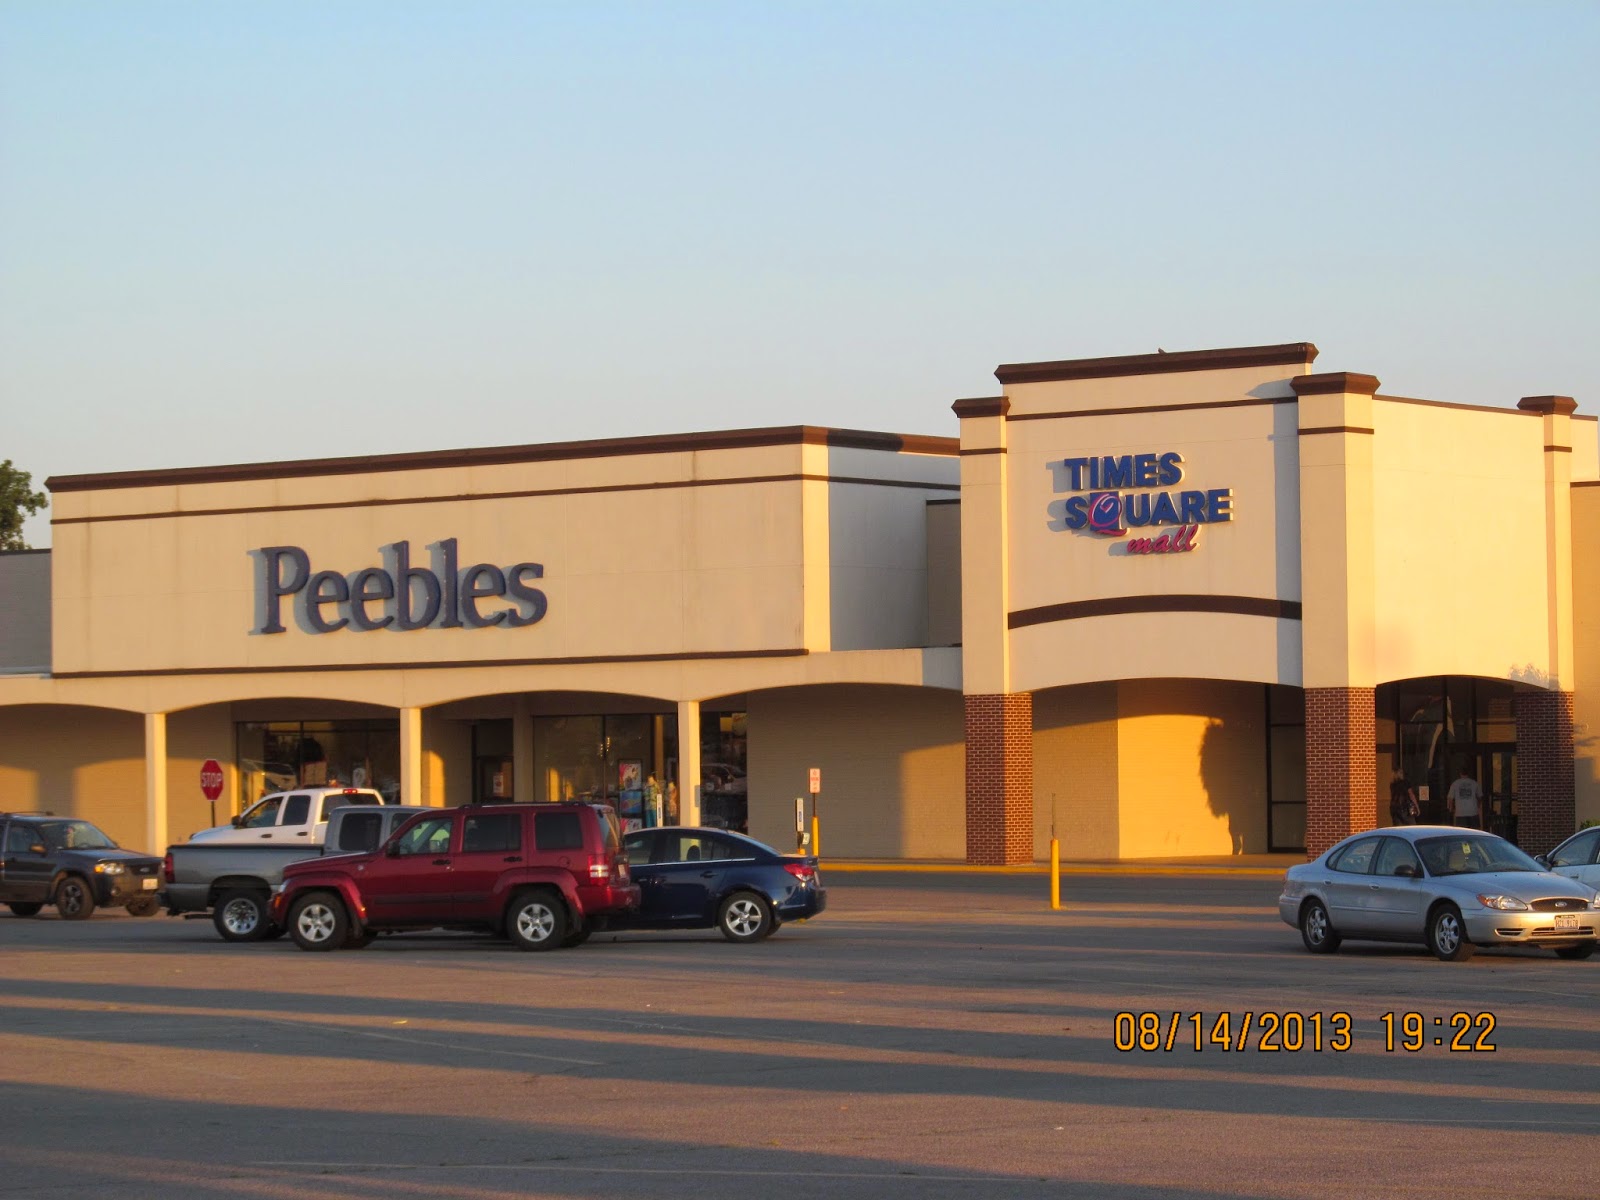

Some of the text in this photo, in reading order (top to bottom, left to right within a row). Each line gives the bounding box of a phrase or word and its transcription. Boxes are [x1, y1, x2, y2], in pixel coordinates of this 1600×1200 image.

[1064, 452, 1185, 490] TIMES
[1064, 488, 1234, 536] SQUARE
[1126, 524, 1202, 554] mall
[260, 537, 548, 633] Peebles
[201, 772, 222, 787] STOP
